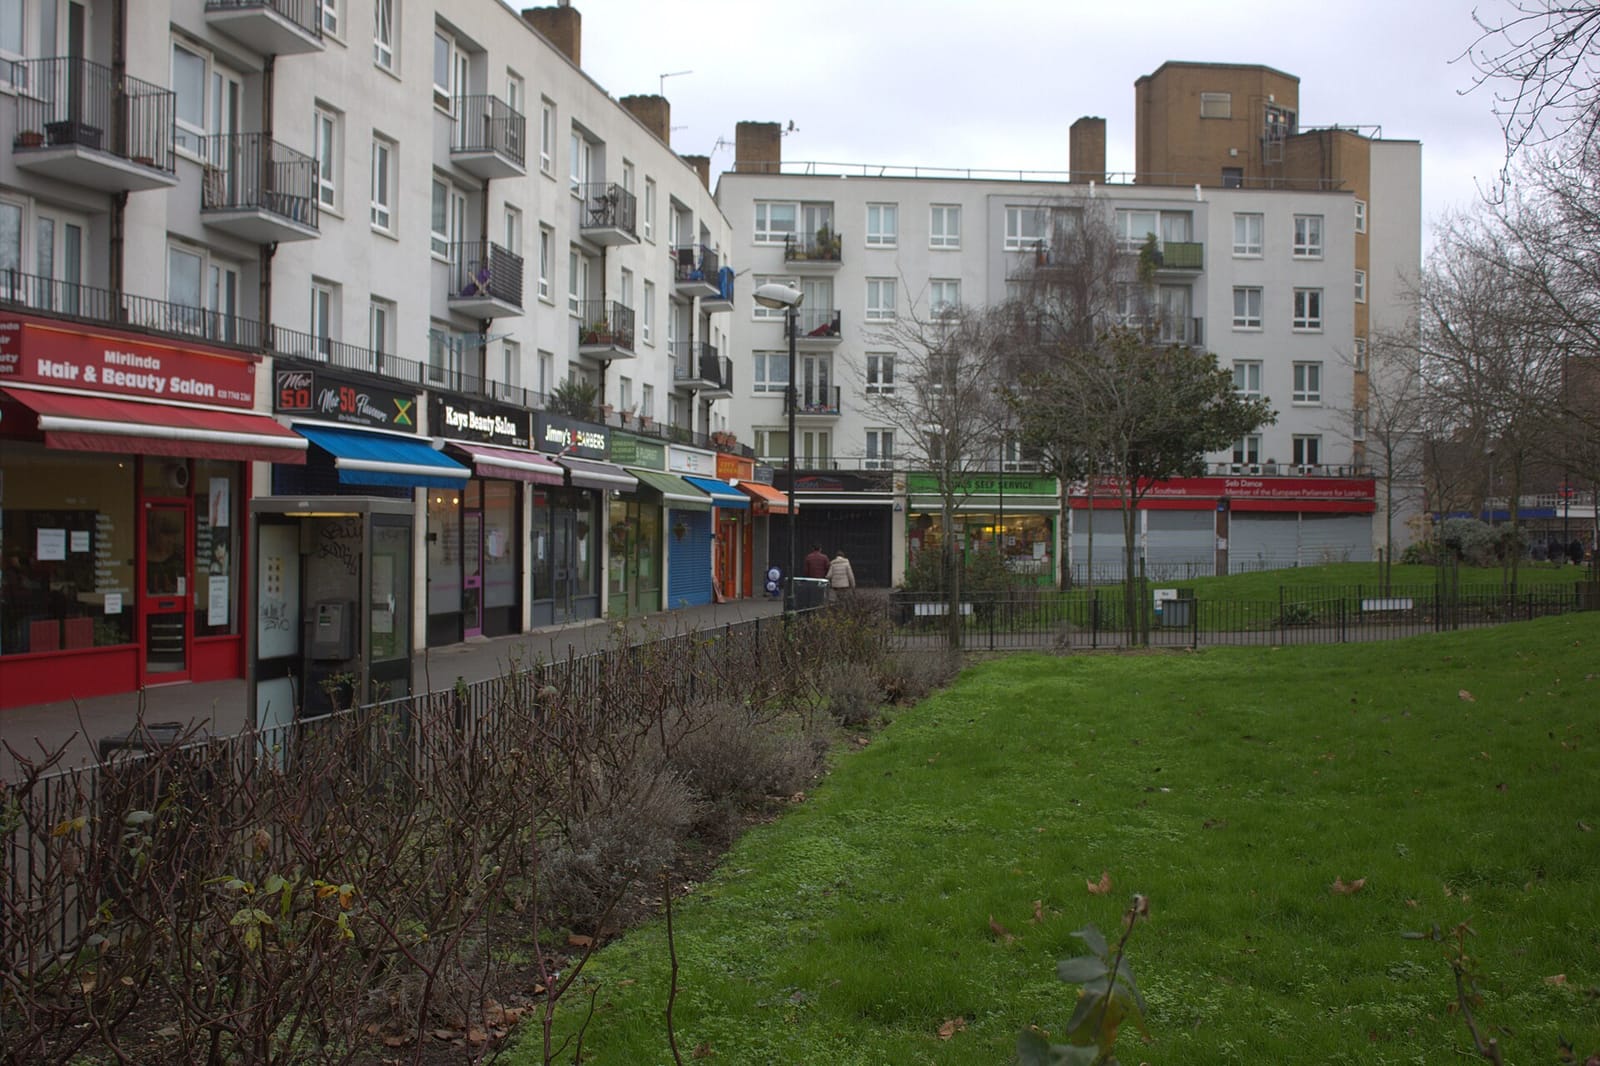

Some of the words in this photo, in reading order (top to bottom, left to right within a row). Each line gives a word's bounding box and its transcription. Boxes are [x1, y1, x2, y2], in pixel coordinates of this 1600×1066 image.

[104, 350, 160, 370] Mirlinda
[37, 358, 79, 380] Hair
[83, 365, 97, 382] &
[102, 367, 166, 393] Beauty
[170, 376, 215, 397] Salon
[281, 389, 309, 408] 50
[339, 386, 356, 414] 50
[445, 405, 468, 432] Kays
[468, 410, 495, 437] Beauty
[494, 415, 517, 436] Salon
[545, 424, 571, 447] Jimmy's
[975, 480, 995, 488] SELF
[1225, 488, 1251, 496] Member
[1253, 488, 1260, 496] of
[1272, 489, 1301, 498] European
[1302, 489, 1333, 497] Parliament
[1344, 489, 1368, 498] London
[1241, 480, 1263, 488] Dance
